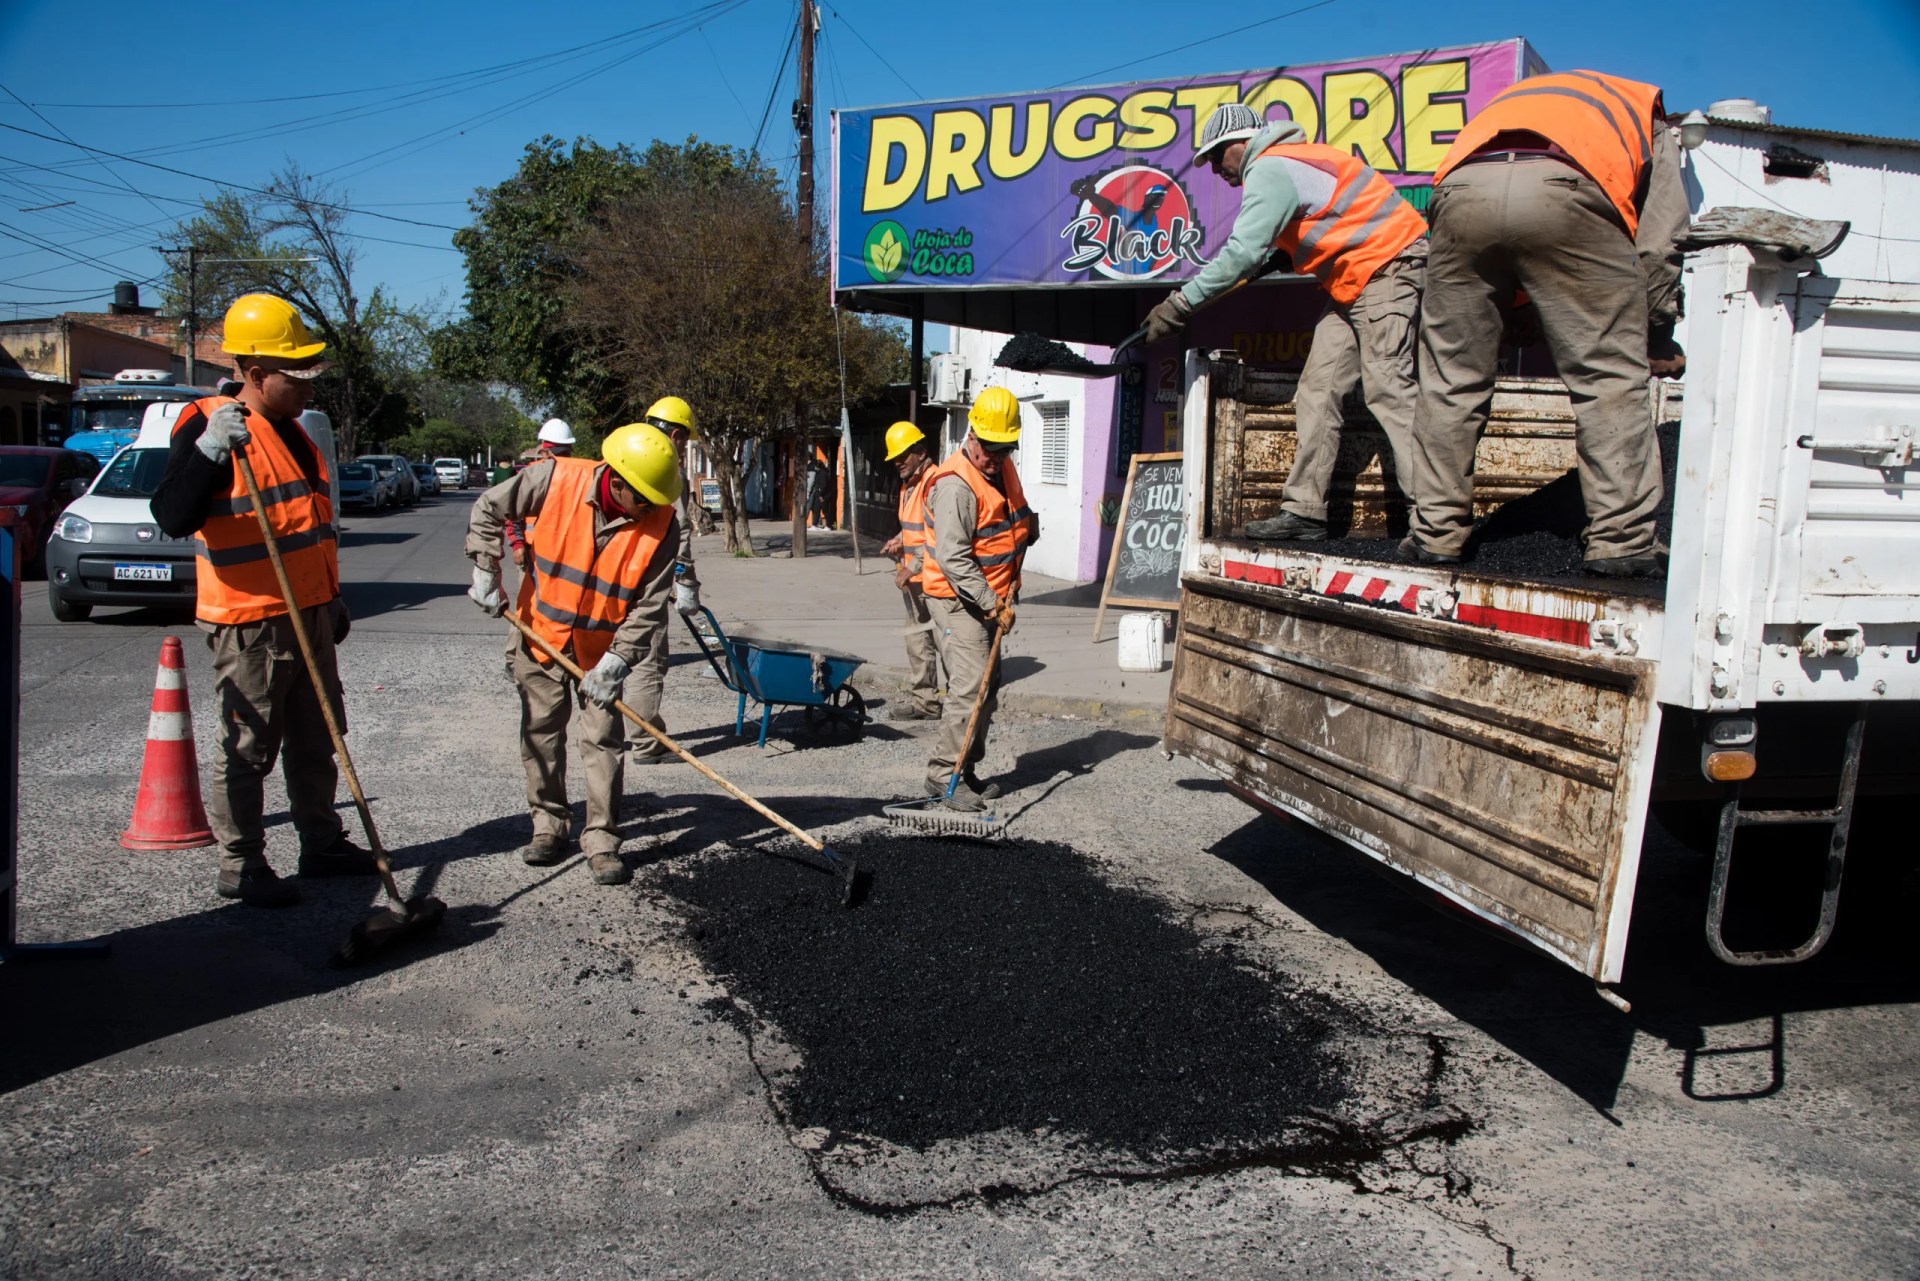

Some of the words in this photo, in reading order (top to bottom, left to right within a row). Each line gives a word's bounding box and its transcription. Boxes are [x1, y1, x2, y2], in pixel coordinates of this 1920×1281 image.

[913, 228, 951, 251] Hoja
[952, 226, 973, 248] de
[1060, 213, 1211, 272] Black
[911, 247, 974, 276] Coca
[1144, 467, 1159, 483] SE
[1164, 467, 1183, 482] VEN
[1144, 484, 1183, 512] HOJ
[117, 568, 130, 578] AC
[133, 569, 153, 579] 621
[156, 570, 169, 580] VY
